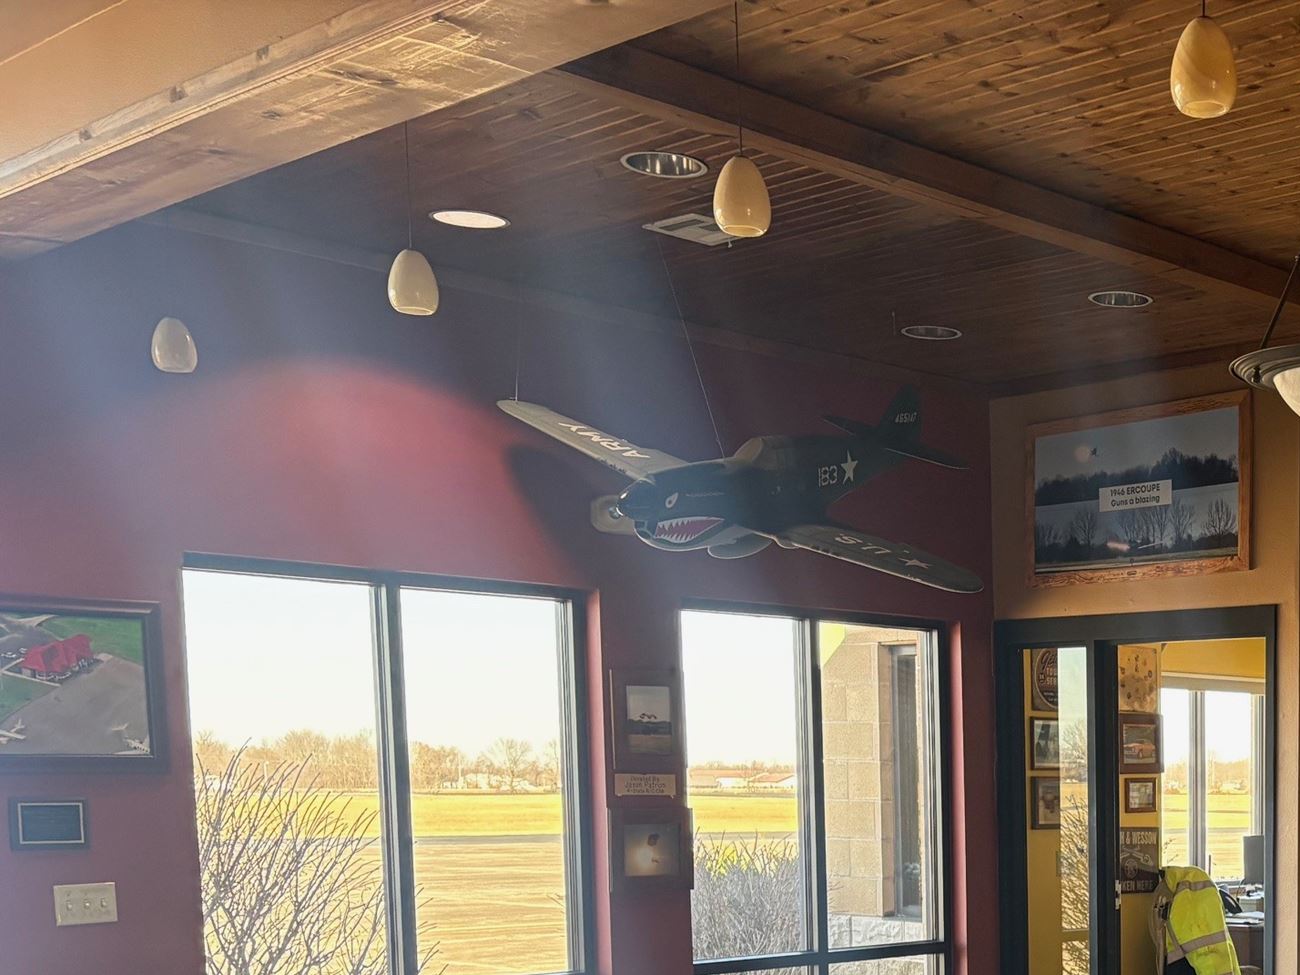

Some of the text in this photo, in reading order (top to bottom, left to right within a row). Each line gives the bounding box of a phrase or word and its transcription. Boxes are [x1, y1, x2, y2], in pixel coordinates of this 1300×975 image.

[558, 422, 651, 458] ARMY
[818, 465, 838, 487] 183
[1110, 483, 1161, 497] 1946 ERCOUPE
[1110, 499, 1129, 507] Guns
[1135, 495, 1160, 504] blazing
[1131, 831, 1157, 845] WESSON
